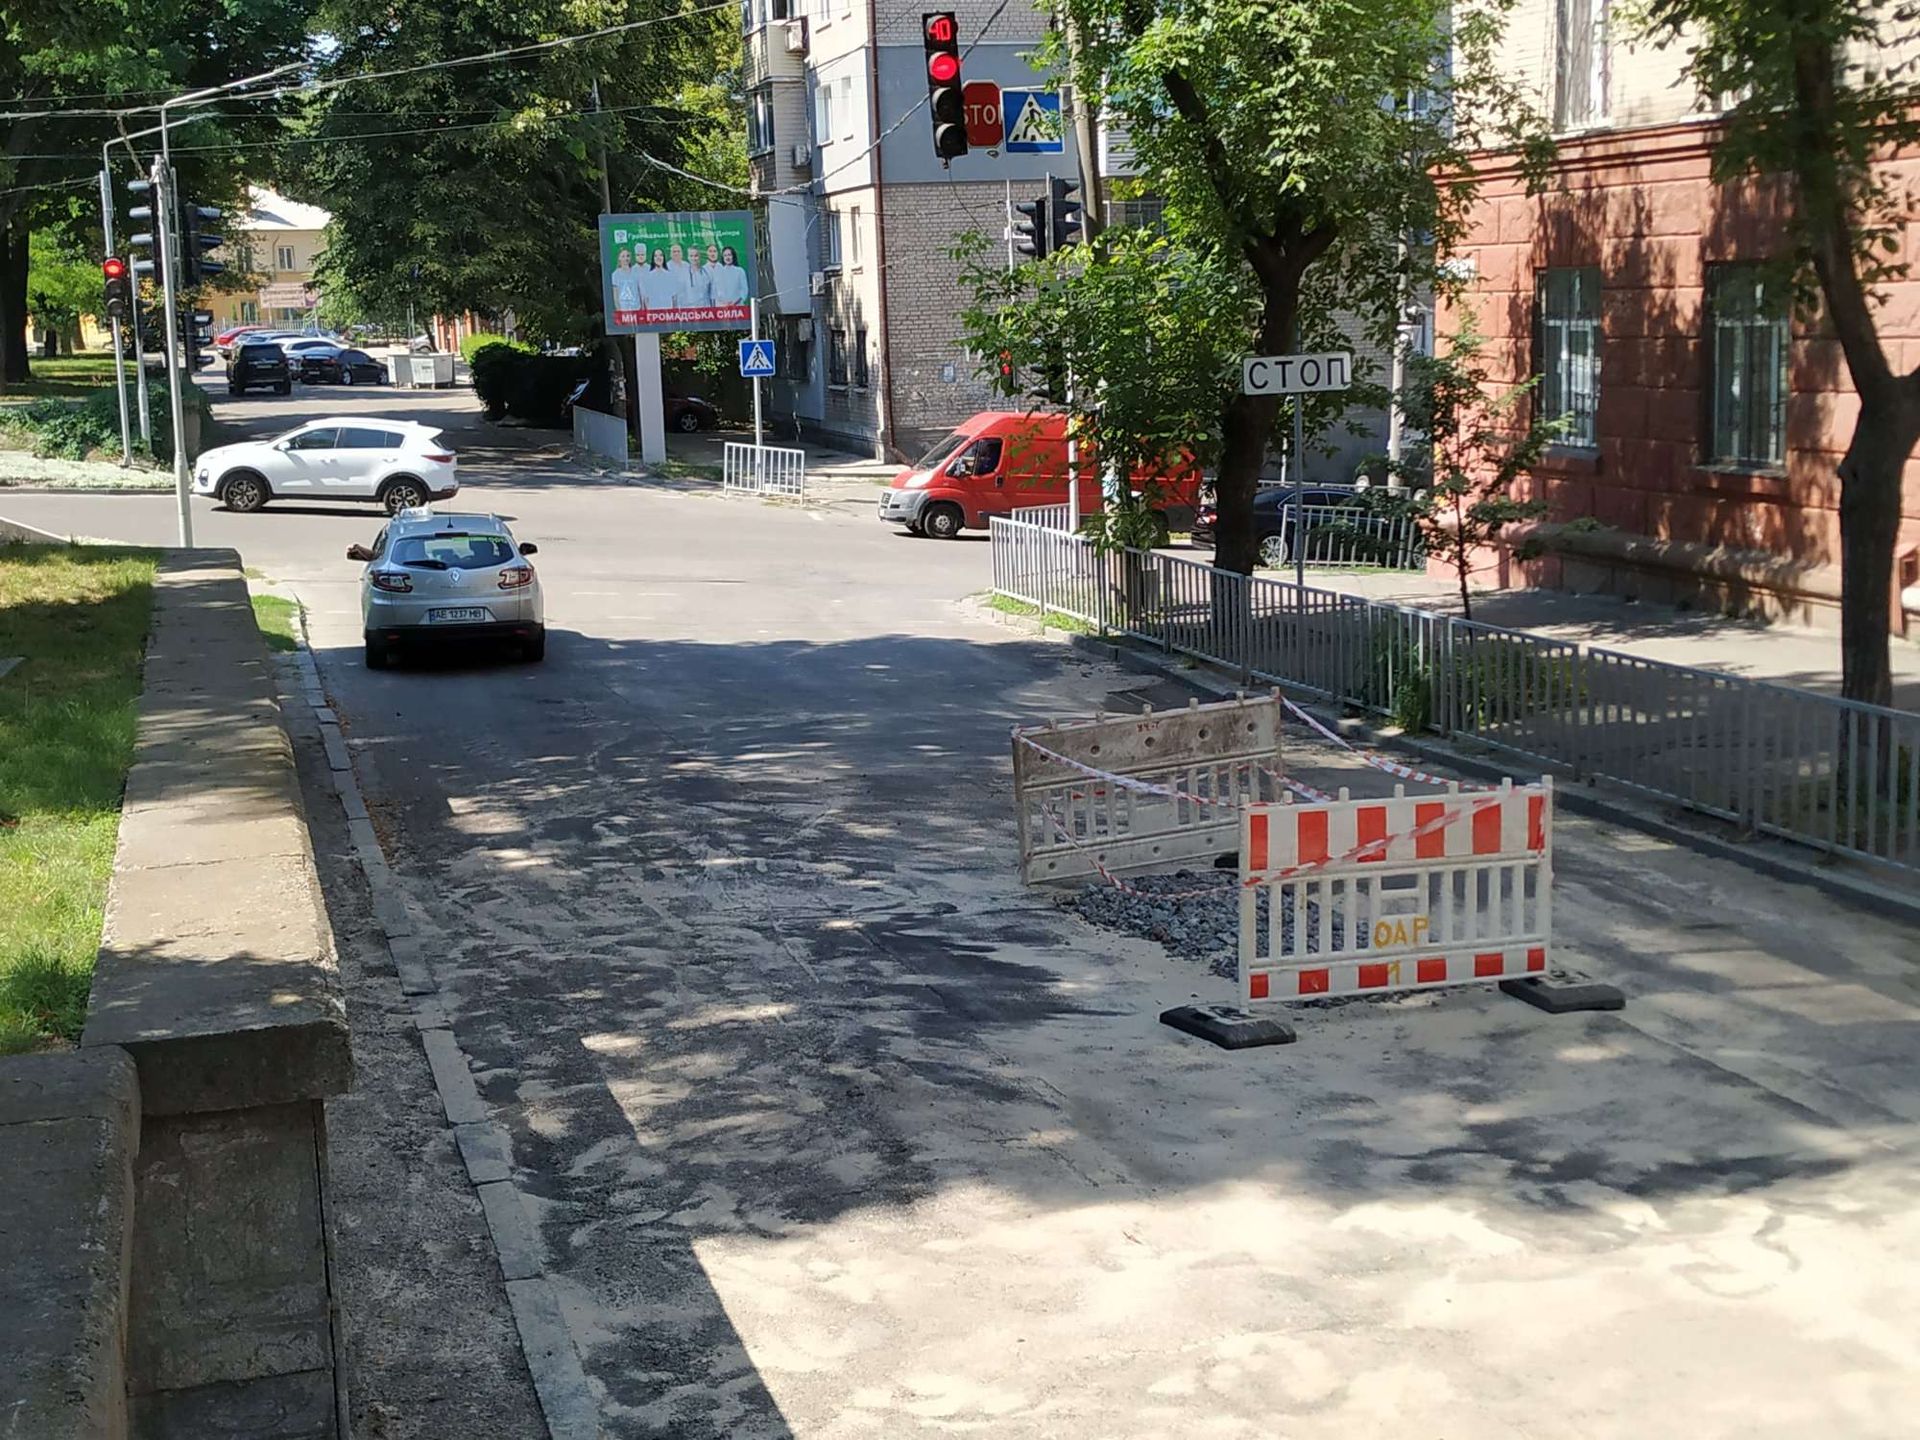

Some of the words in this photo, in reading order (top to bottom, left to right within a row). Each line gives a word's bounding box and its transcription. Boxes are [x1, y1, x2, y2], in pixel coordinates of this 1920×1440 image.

[928, 19, 951, 41] 40
[621, 312, 638, 323] МИ
[646, 310, 716, 322] ГРОМАДСЬКА
[716, 308, 745, 320] СИЛА
[1249, 357, 1345, 389] СТОП
